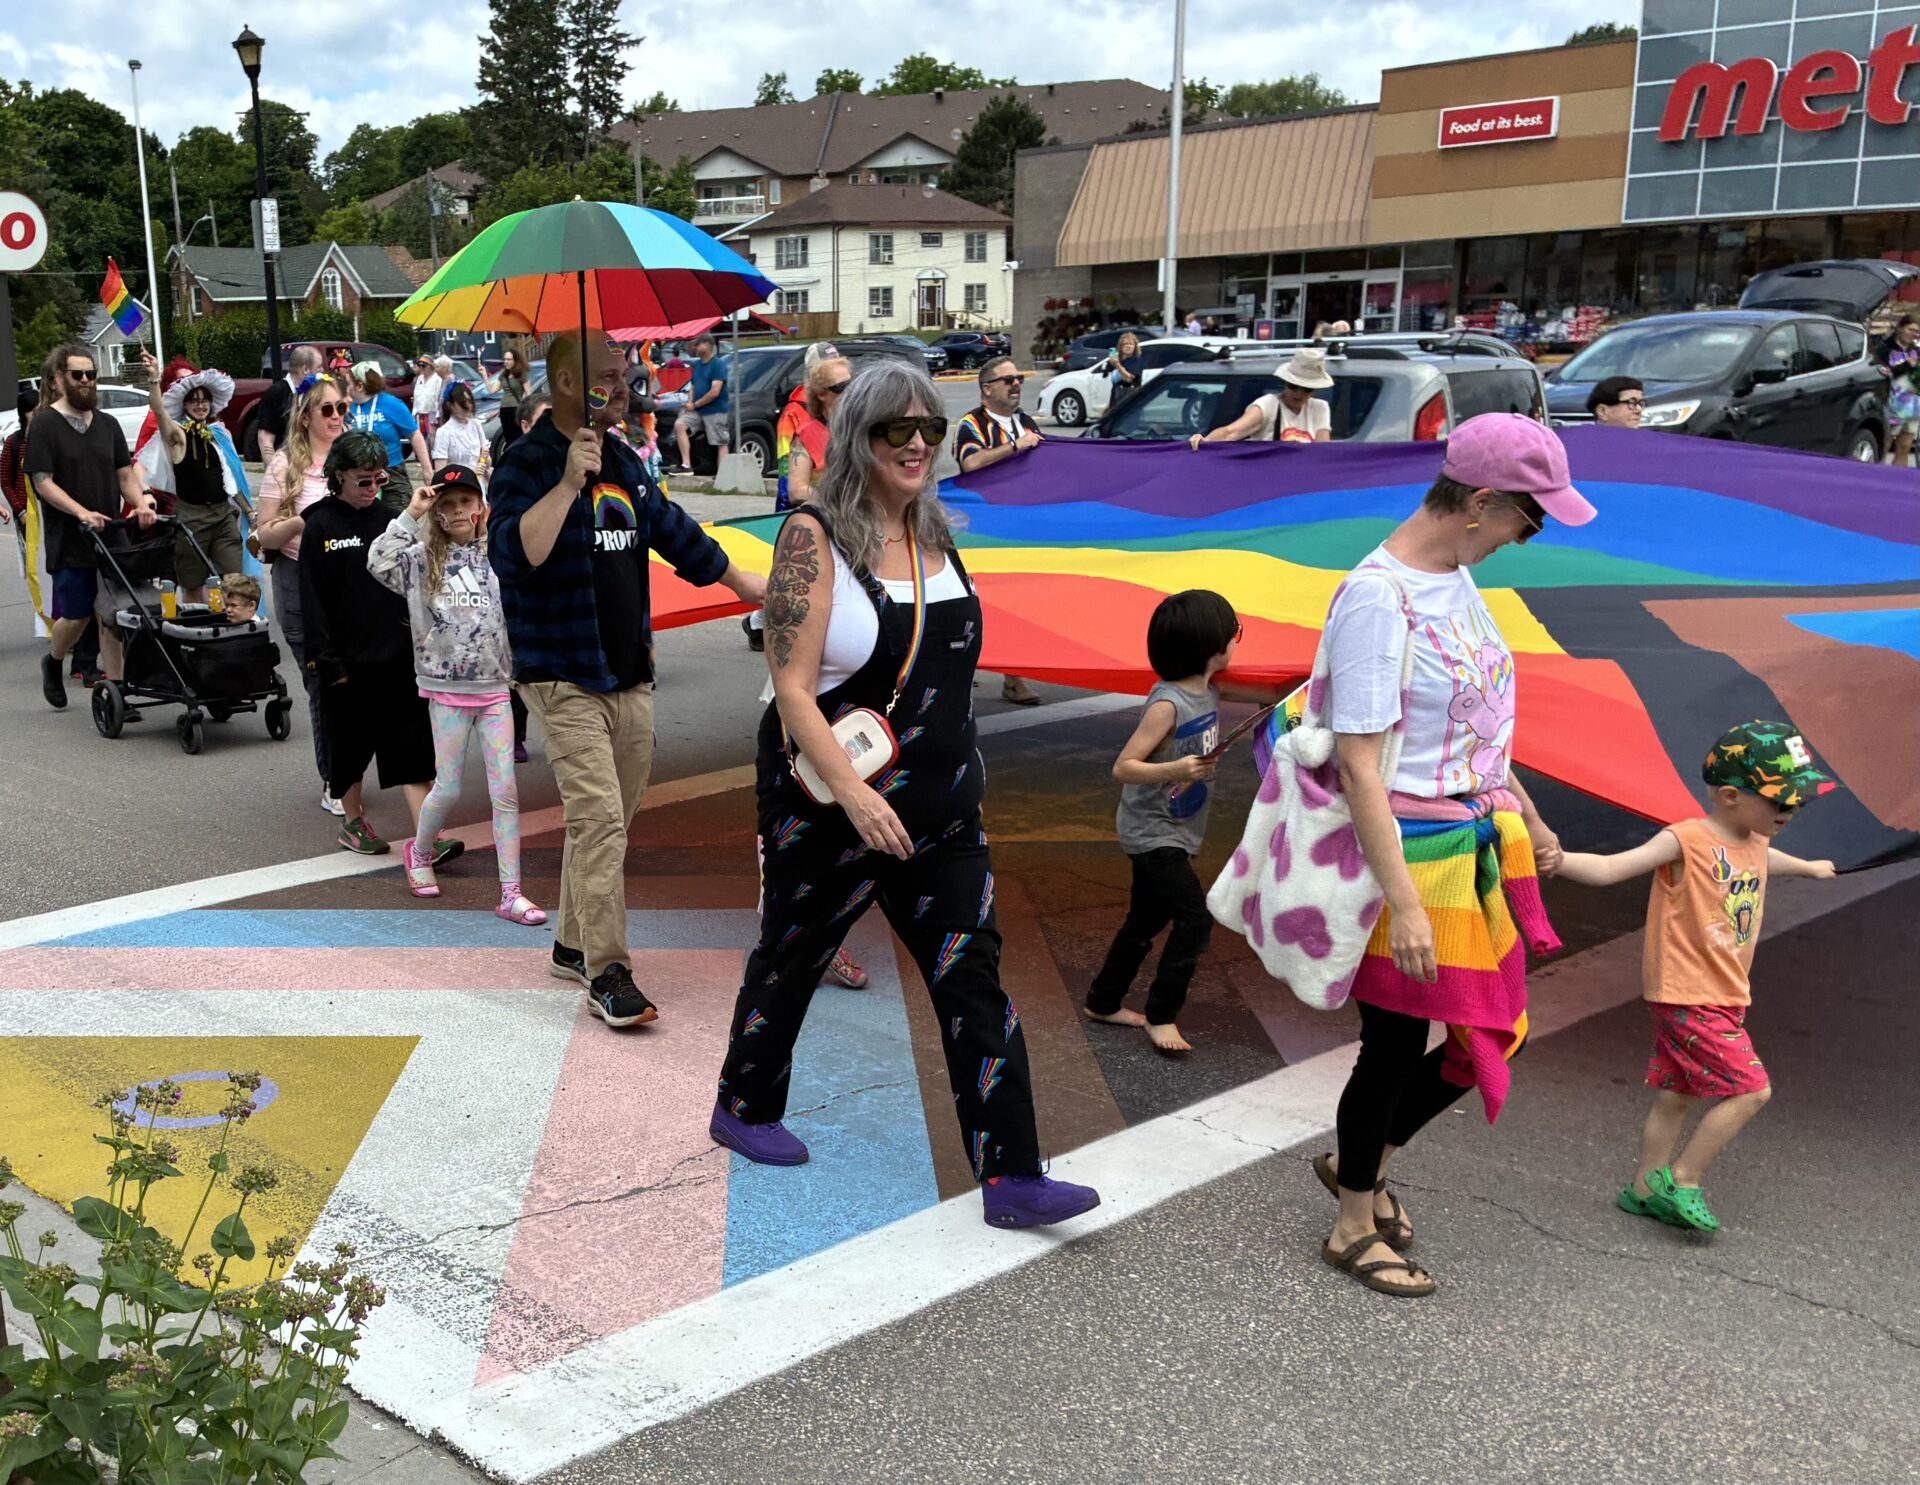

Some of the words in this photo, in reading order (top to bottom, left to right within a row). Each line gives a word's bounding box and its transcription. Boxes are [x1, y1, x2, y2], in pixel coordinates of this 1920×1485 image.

[1656, 24, 1920, 143] met
[1449, 118, 1481, 135] Food
[1481, 119, 1495, 131] at
[1497, 116, 1512, 130] its
[1513, 114, 1544, 128] best.
[435, 592, 491, 608] adidas
